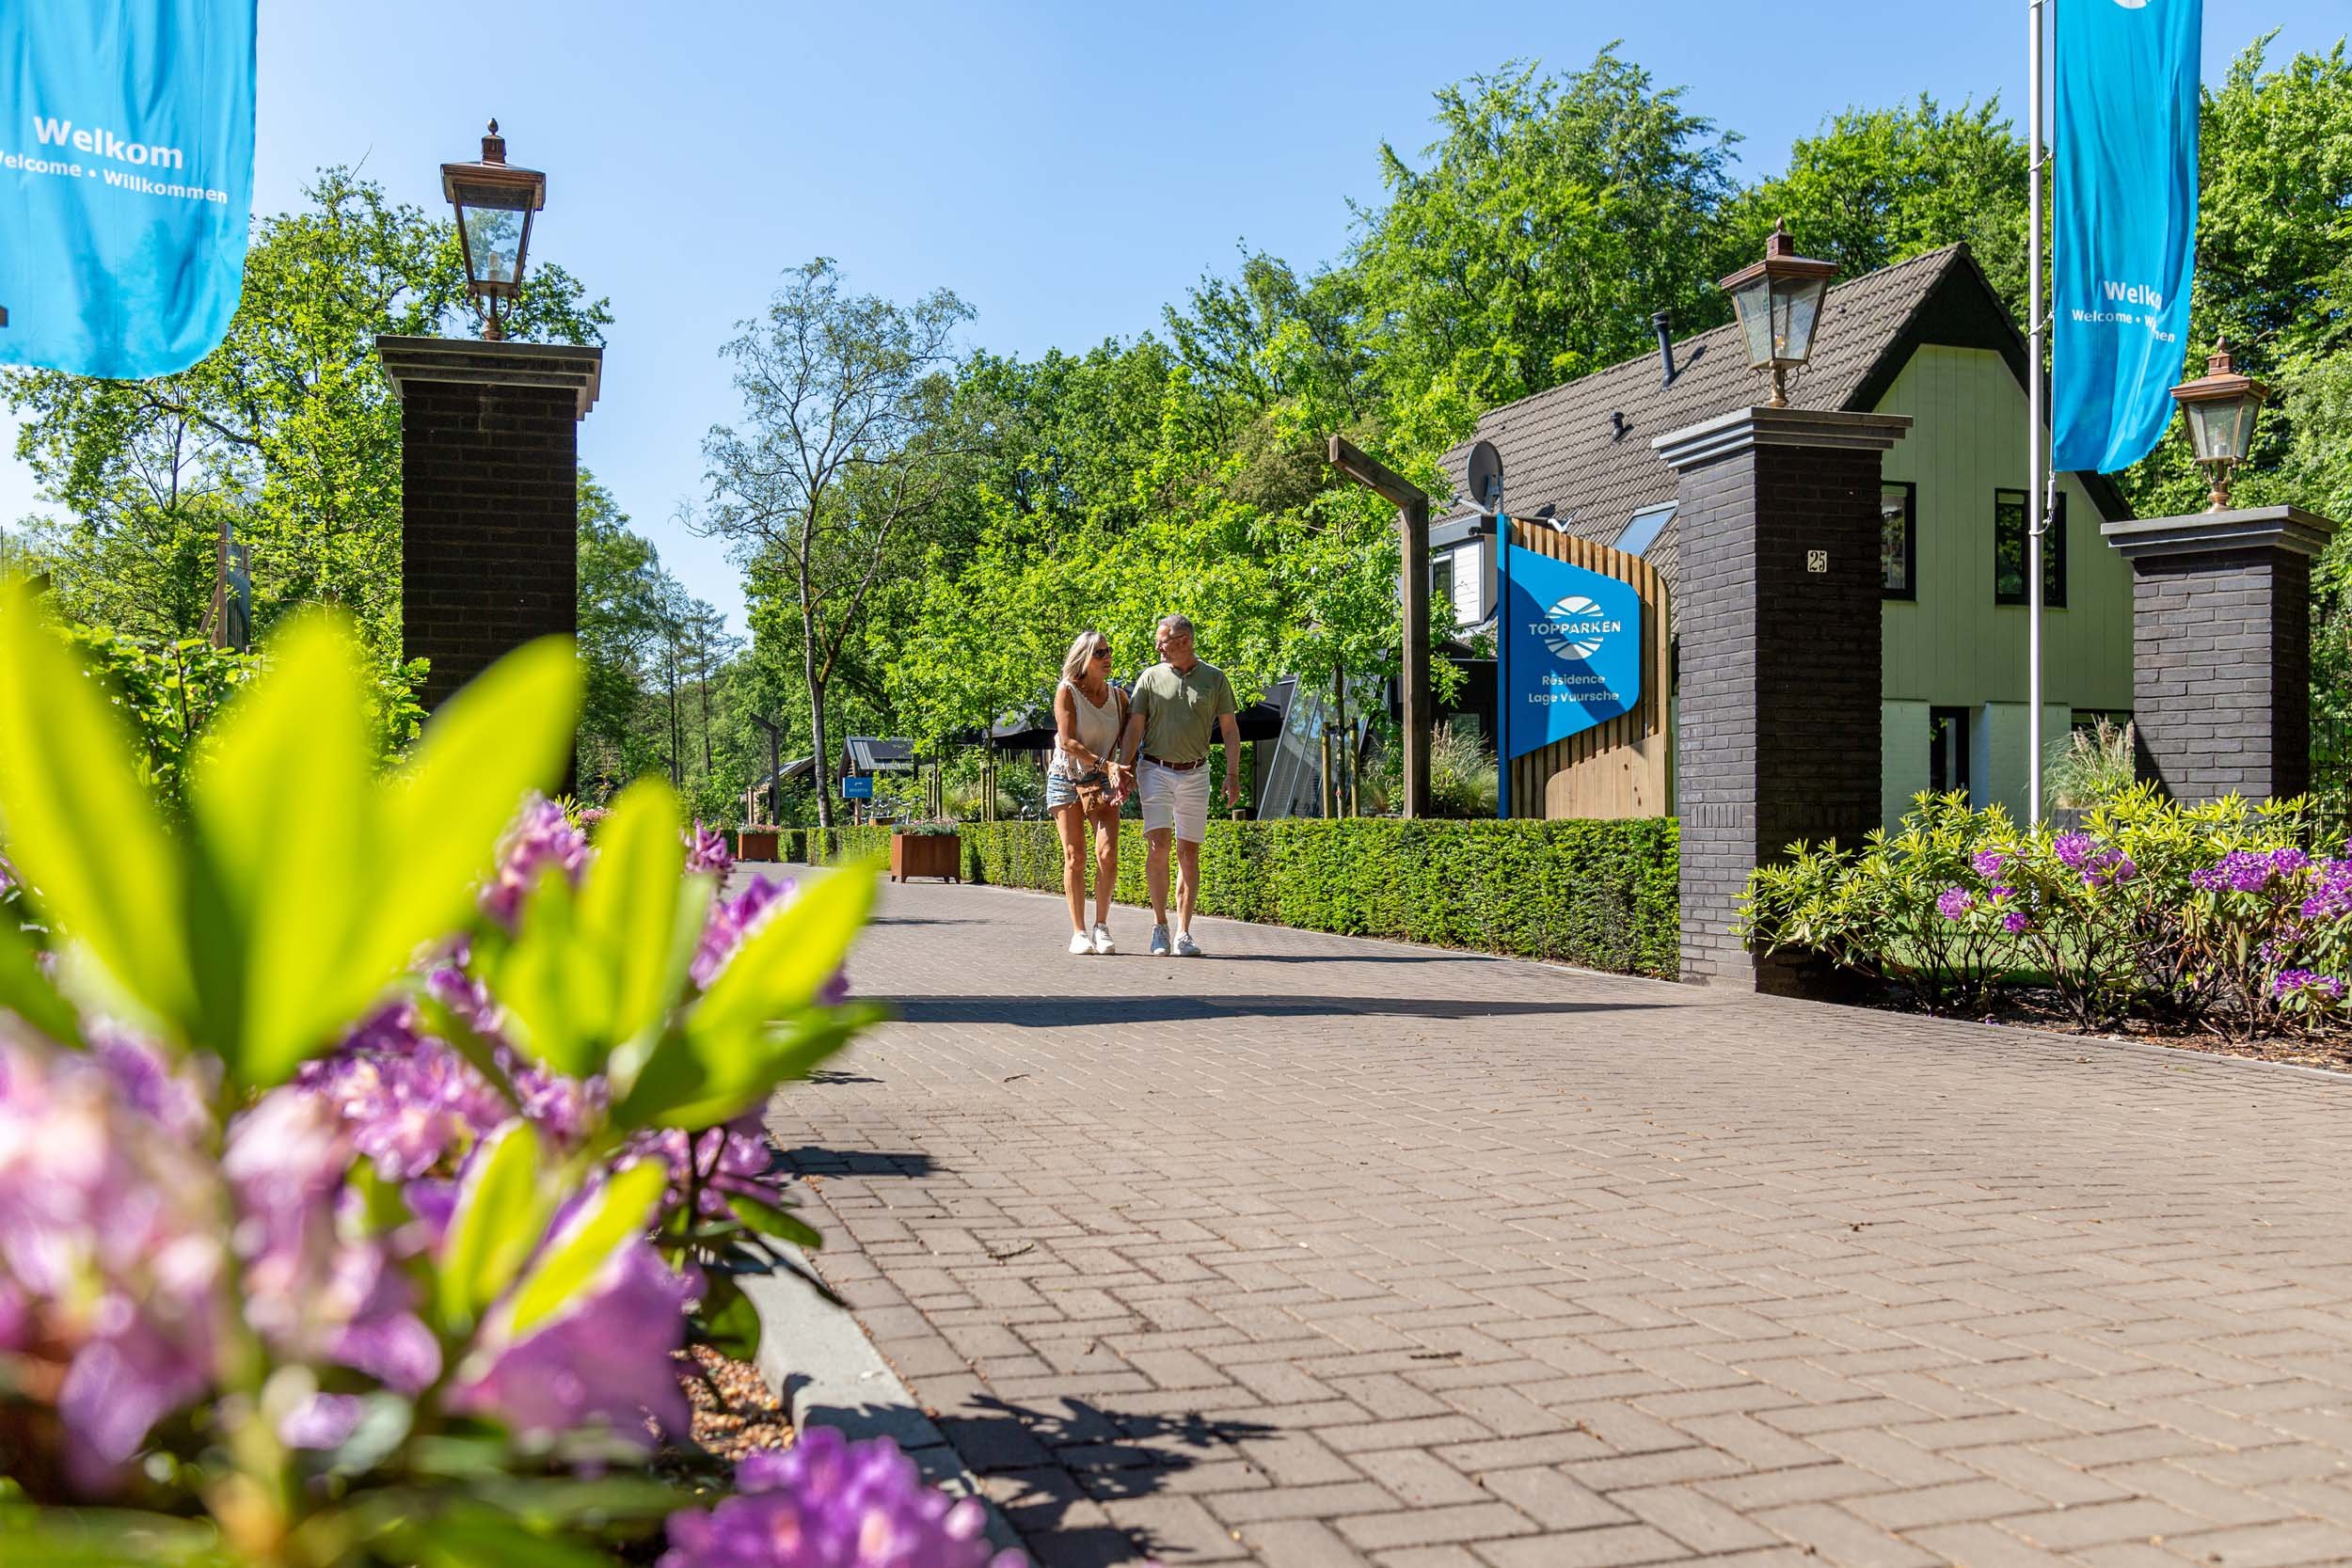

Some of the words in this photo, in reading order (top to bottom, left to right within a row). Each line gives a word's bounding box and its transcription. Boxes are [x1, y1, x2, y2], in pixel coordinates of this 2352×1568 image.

[33, 116, 183, 168] Welkom
[103, 168, 228, 203] Willkommen
[2072, 309, 2133, 324] Welcome
[1809, 551, 1825, 572] 25
[1529, 620, 1621, 635] TOPPARKEN
[1542, 673, 1605, 686] Résidence
[1529, 693, 1558, 705] Lage
[1561, 690, 1619, 703] Vuursche
